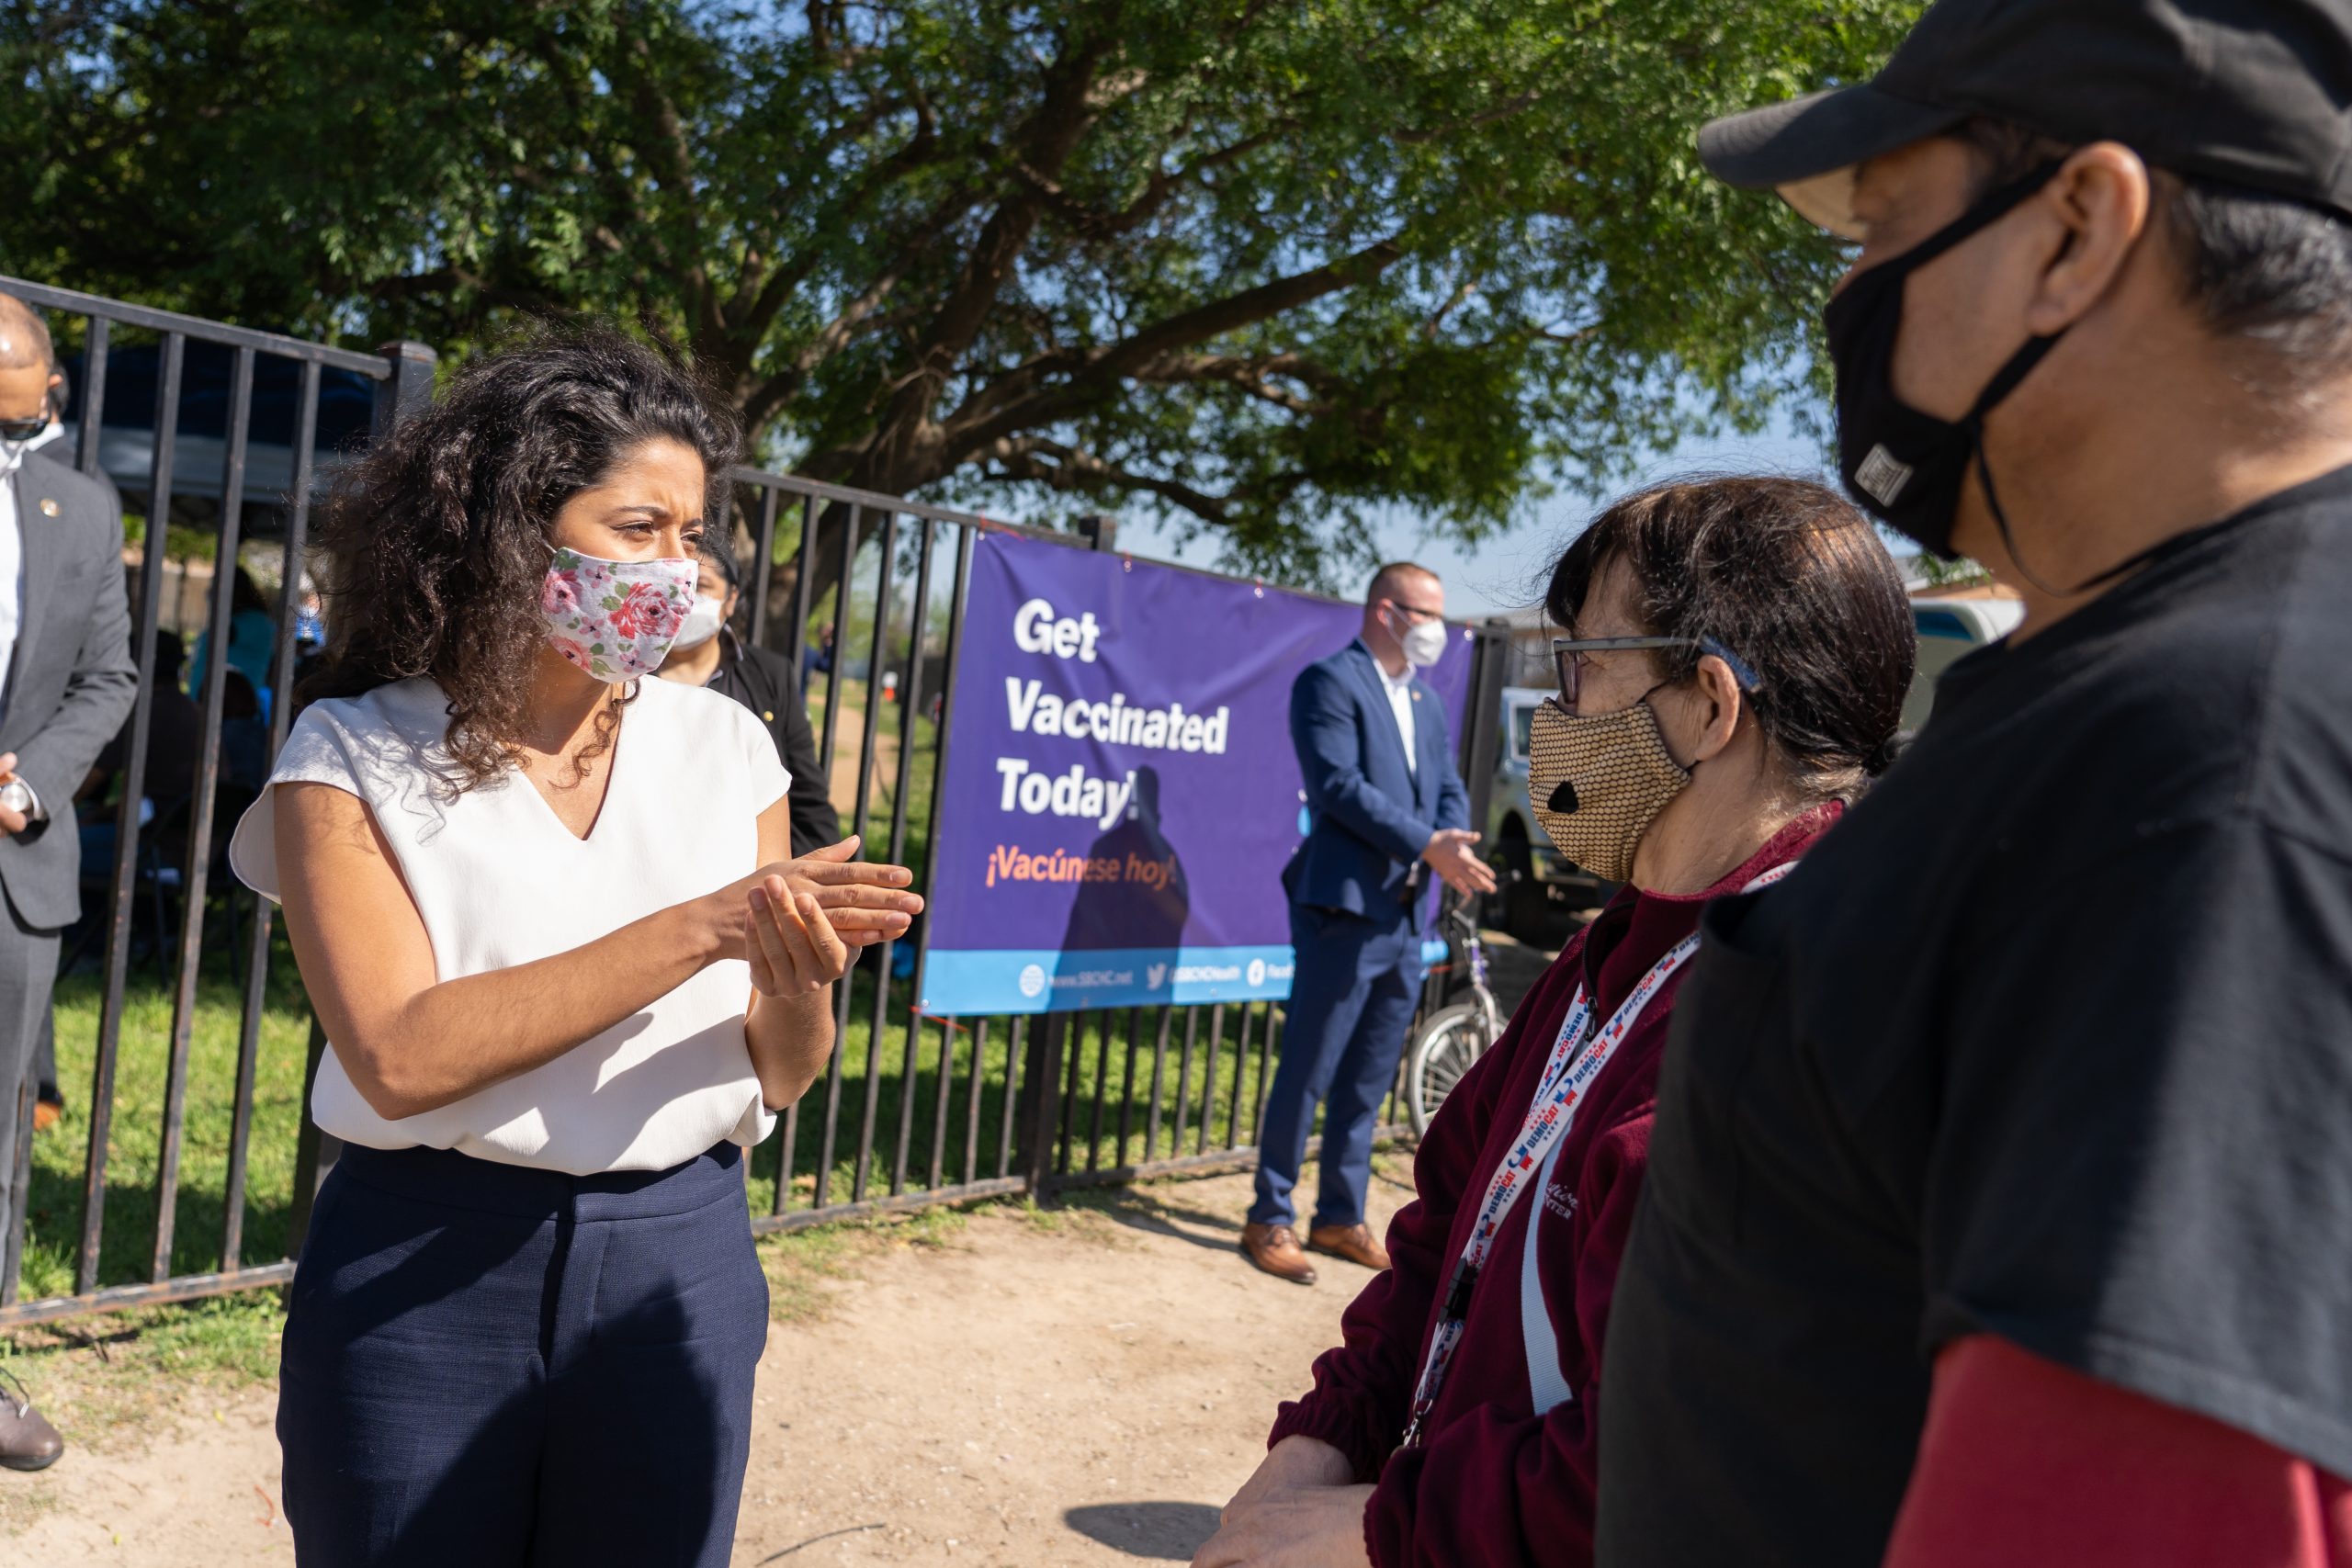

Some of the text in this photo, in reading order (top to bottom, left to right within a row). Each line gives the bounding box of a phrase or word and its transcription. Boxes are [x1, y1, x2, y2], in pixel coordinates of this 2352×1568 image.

[1013, 598, 1100, 663] Get
[1005, 676, 1230, 755] Vaccinated
[996, 757, 1139, 831] Today!
[986, 844, 1177, 891] ¡Vacúnese hoy!
[1557, 1011, 1585, 1059] DEMOCAT
[1574, 1038, 1609, 1084] DEMOCAT
[1525, 1103, 1559, 1149] DEMOCAT
[1488, 1169, 1517, 1214] DEMOCAT
